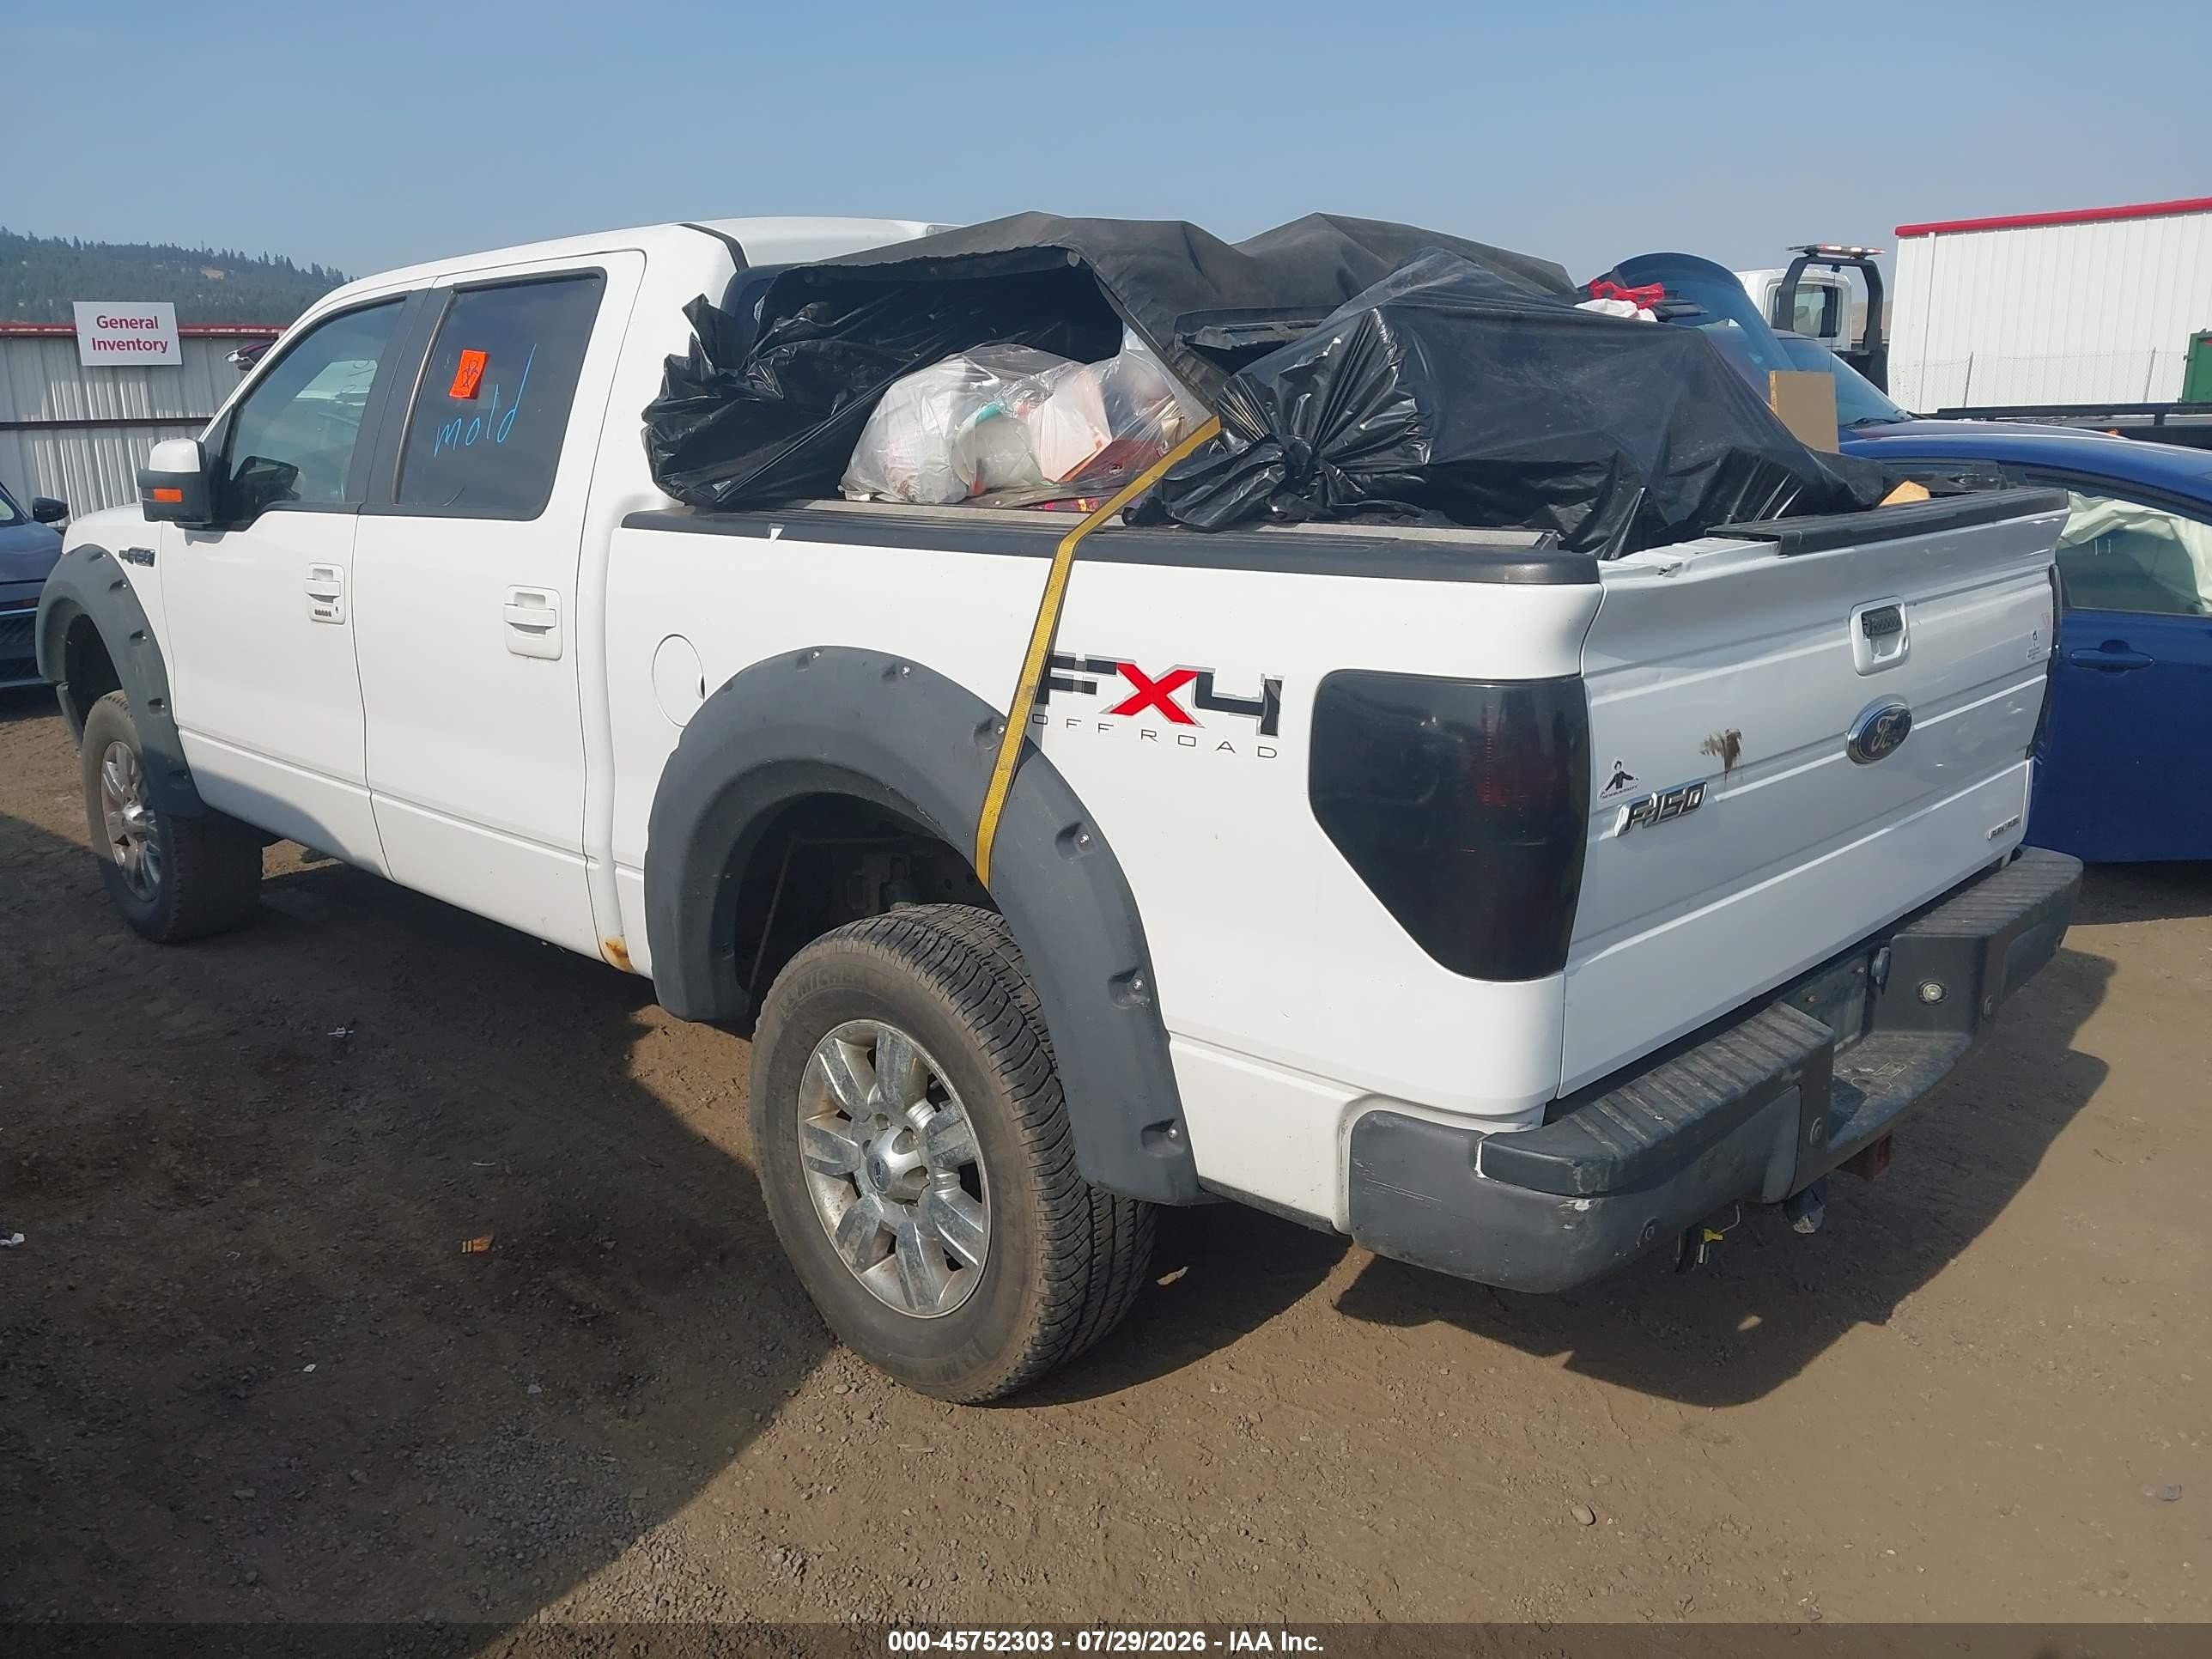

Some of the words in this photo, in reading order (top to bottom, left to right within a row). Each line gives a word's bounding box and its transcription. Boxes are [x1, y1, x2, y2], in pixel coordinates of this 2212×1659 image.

[96, 315, 159, 329] General
[91, 337, 168, 354] Inventory
[434, 343, 537, 457] mold
[1034, 651, 1285, 738] FX4
[1031, 714, 1115, 733] OFF
[1140, 729, 1279, 759] ROAD
